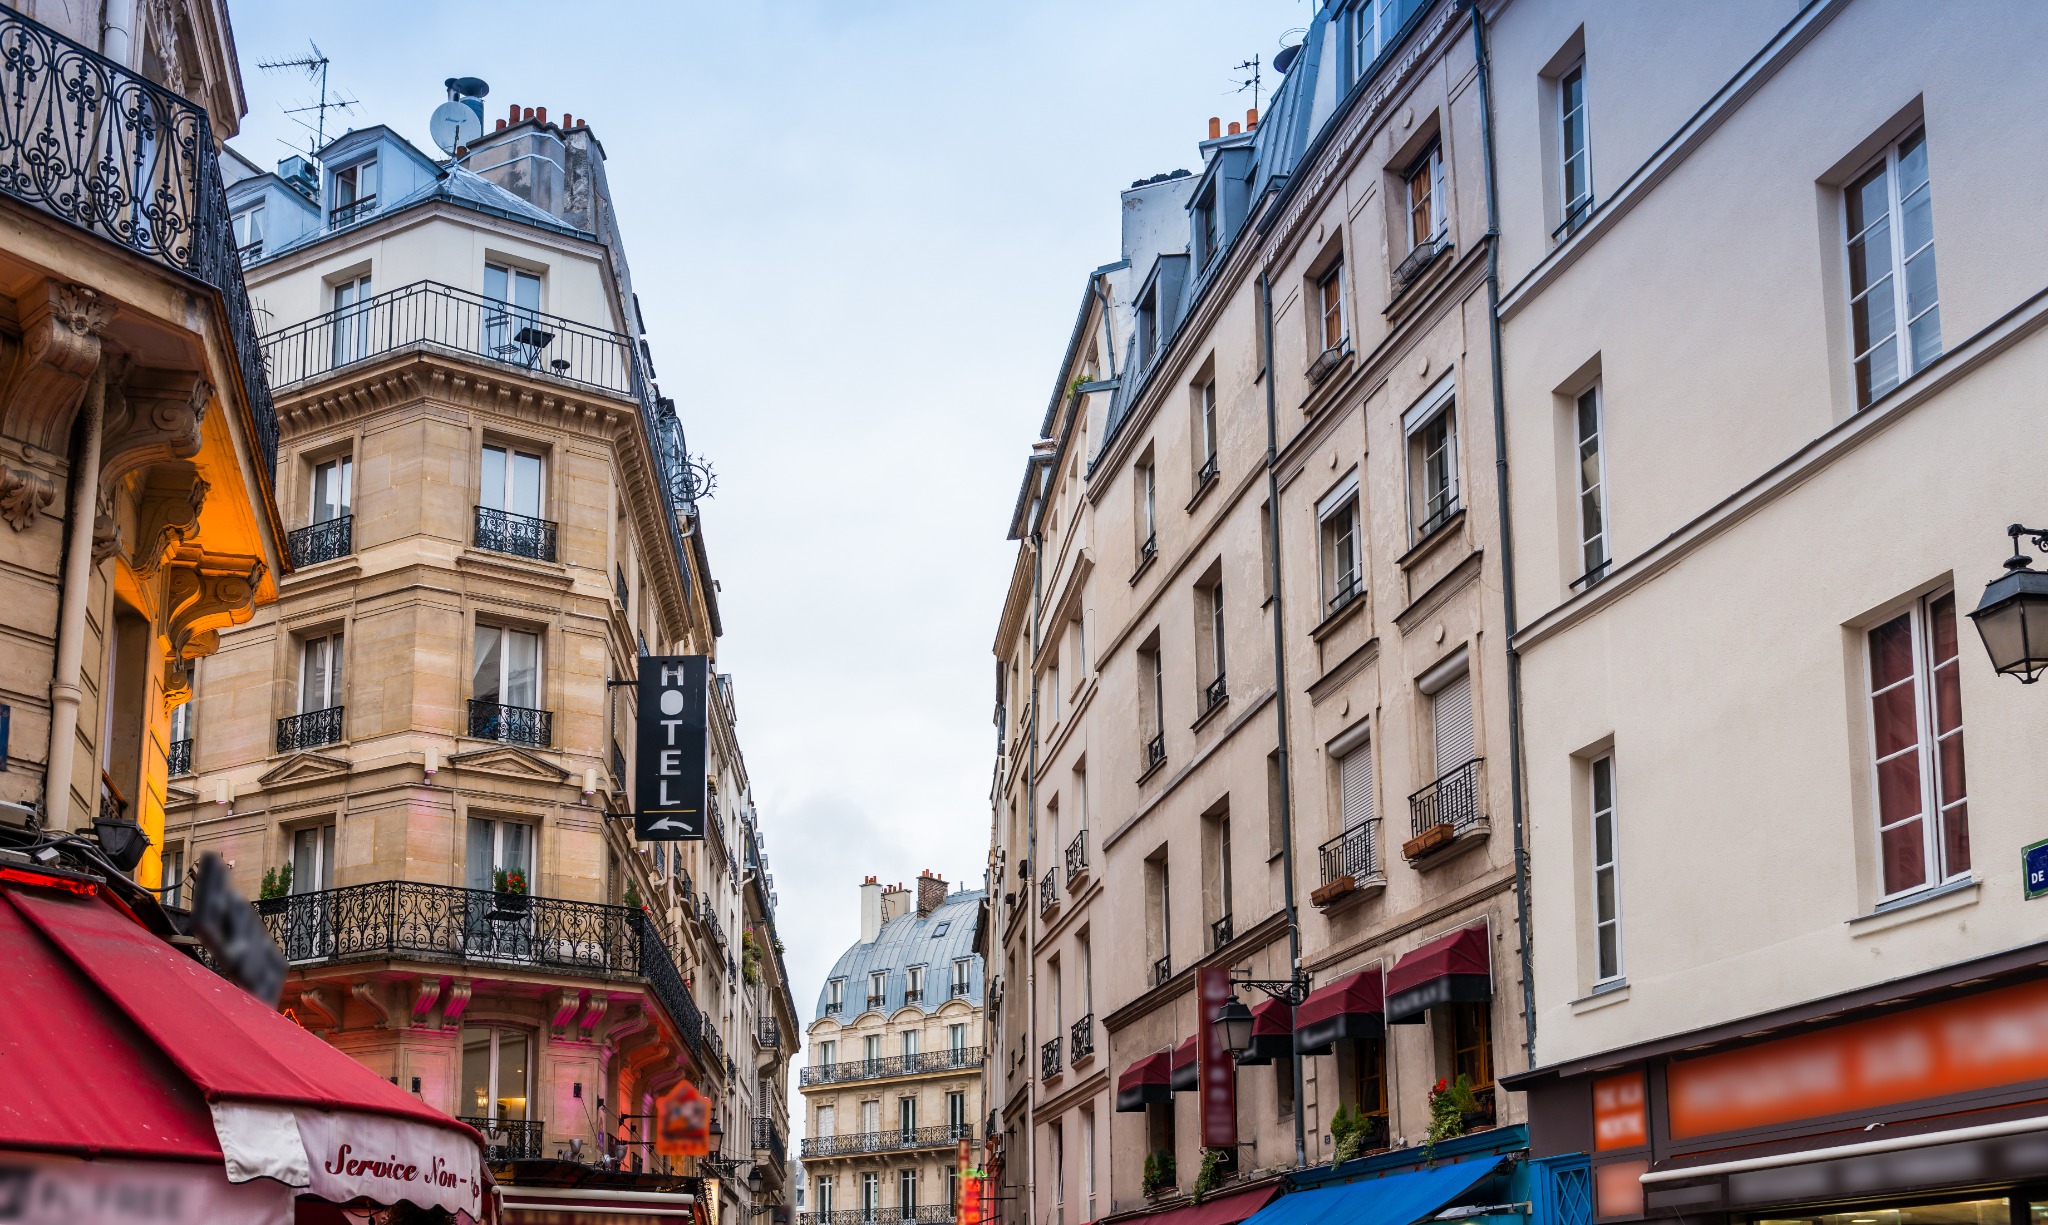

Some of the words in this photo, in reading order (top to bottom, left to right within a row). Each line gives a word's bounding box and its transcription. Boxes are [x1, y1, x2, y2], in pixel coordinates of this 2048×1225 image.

[660, 661, 684, 805] HOTEL
[2031, 870, 2045, 884] DE
[325, 1144, 419, 1181] Service
